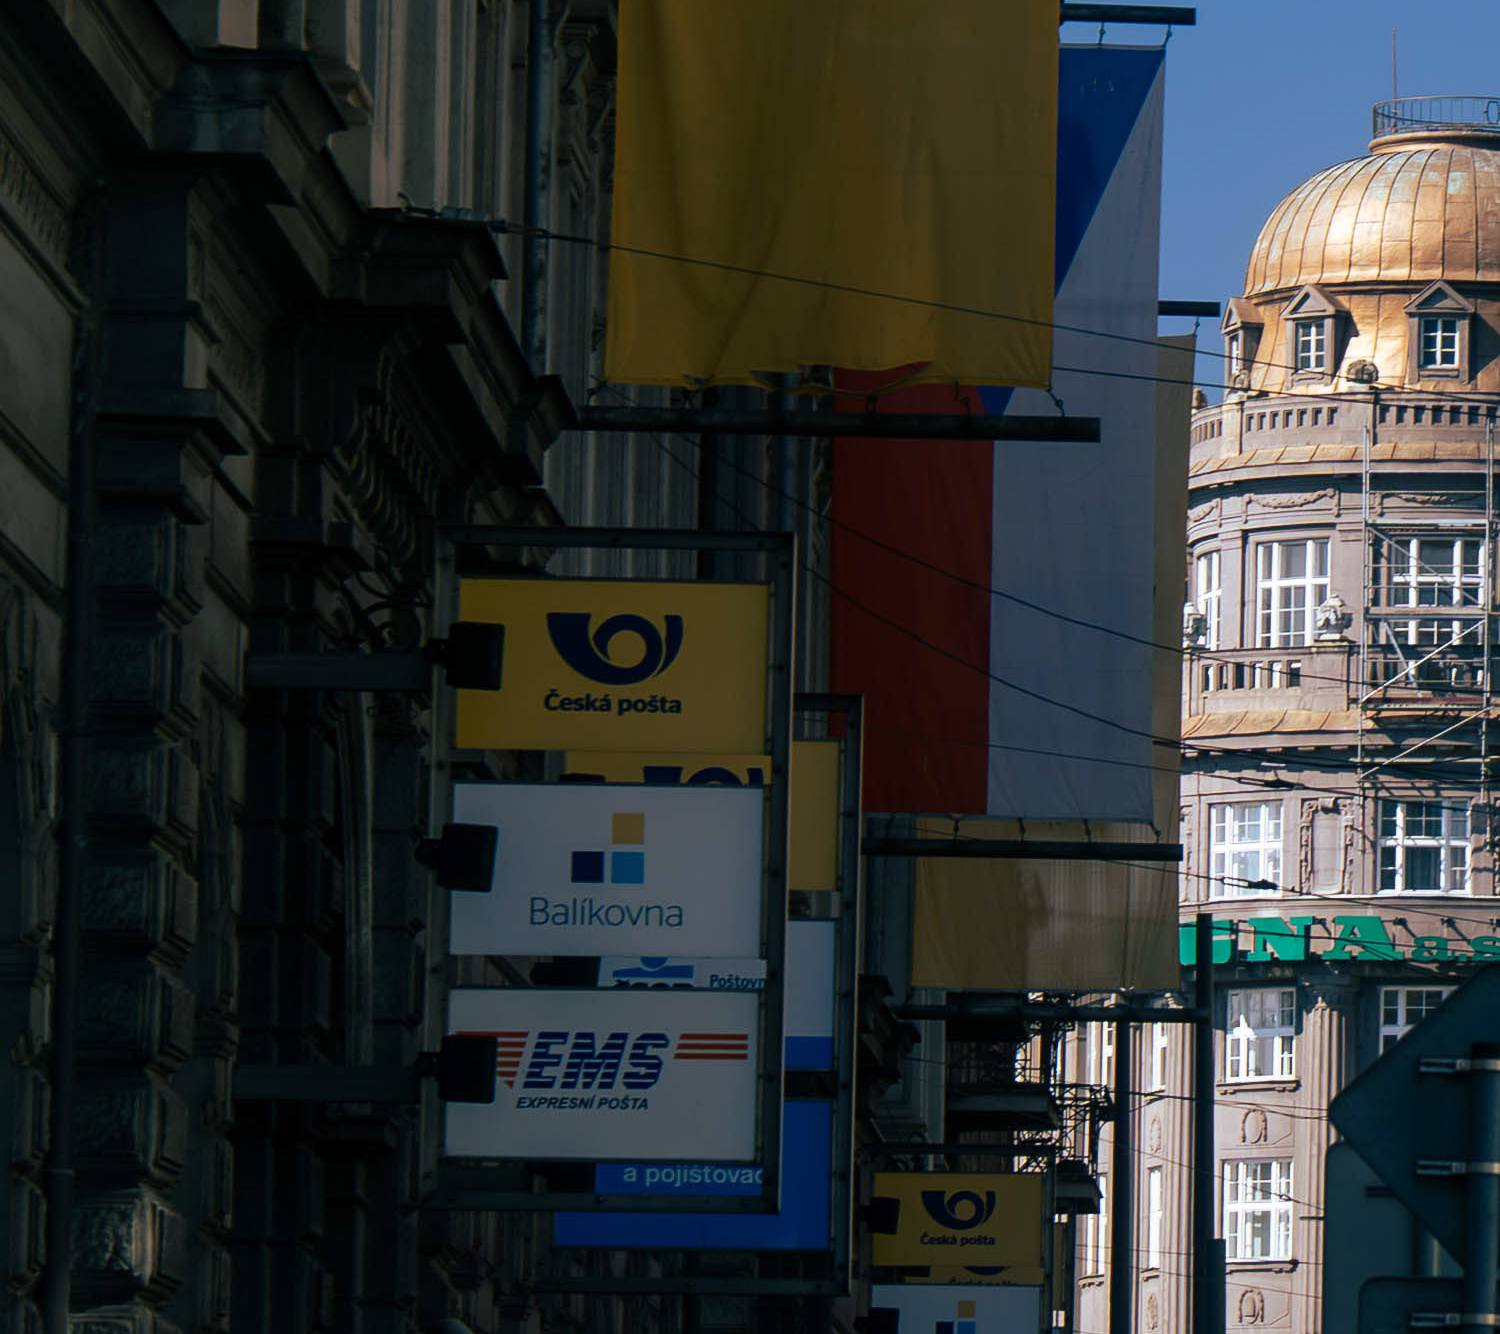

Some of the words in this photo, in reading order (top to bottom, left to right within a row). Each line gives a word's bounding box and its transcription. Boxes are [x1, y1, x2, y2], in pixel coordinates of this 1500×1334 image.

[544, 689, 612, 713] Česká
[617, 693, 683, 716] pošta
[529, 895, 684, 927] Balíkovna
[523, 1031, 669, 1090] EMS
[516, 1094, 595, 1110] EXPRESNÍ
[597, 1095, 649, 1111] POŠTA
[919, 1232, 958, 1245] Česká
[960, 1234, 996, 1247] pošta
